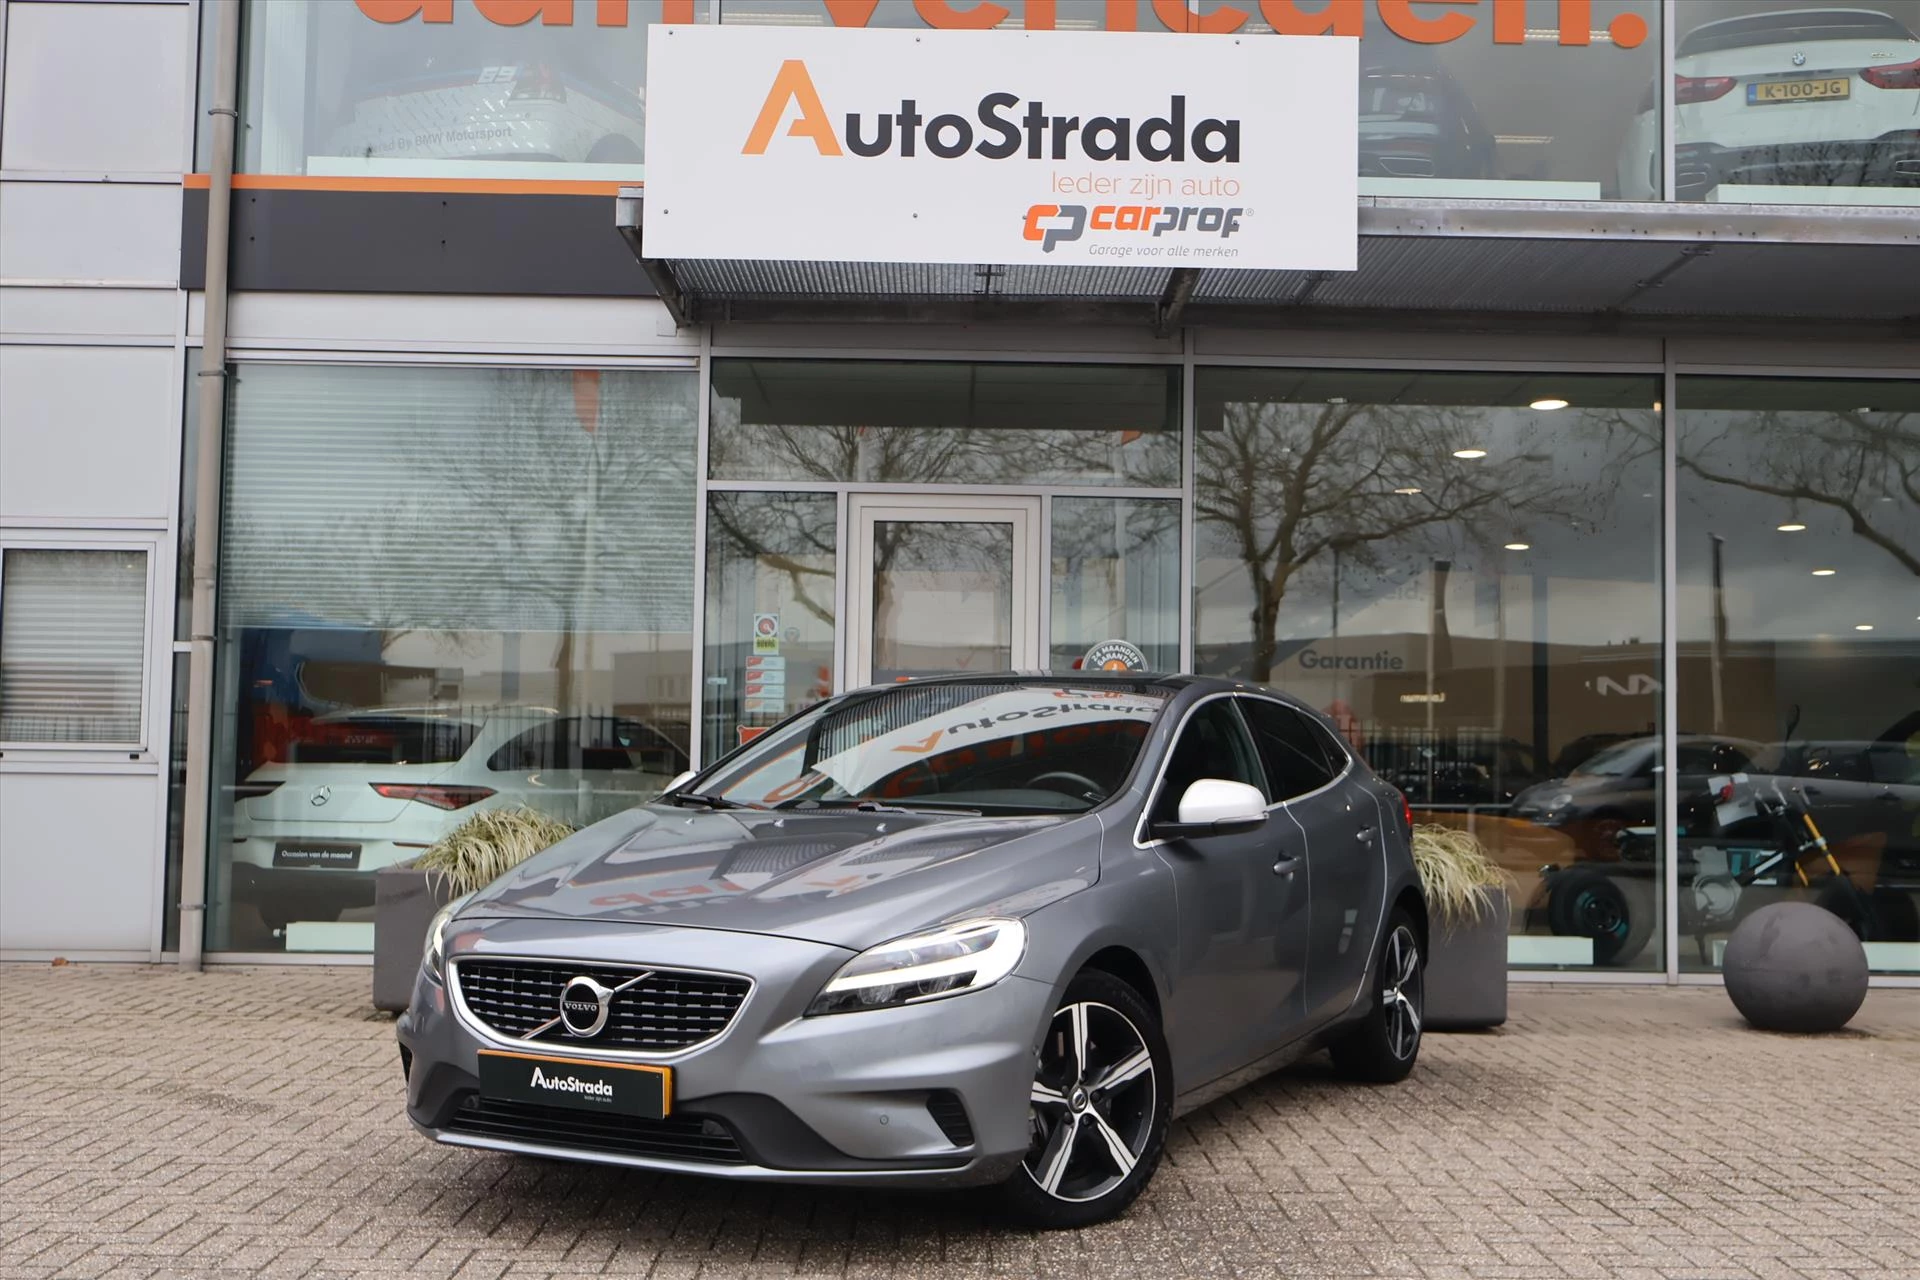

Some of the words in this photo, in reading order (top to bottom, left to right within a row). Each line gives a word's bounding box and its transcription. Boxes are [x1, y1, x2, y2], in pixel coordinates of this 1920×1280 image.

[1765, 81, 1841, 98] K-100-JG
[741, 59, 1240, 162] AutoStrada
[416, 132, 443, 146] BMW
[446, 126, 512, 143] Motorsport
[1052, 171, 1121, 194] Ieder
[1130, 173, 1172, 200] zijn
[1181, 175, 1240, 197] auto
[1089, 244, 1132, 258] Garage
[1137, 248, 1162, 256] voor
[1167, 245, 1189, 256] alle
[1194, 246, 1239, 257] merken
[1091, 650, 1102, 662] 24
[1101, 645, 1140, 663] MAANDEN
[1097, 652, 1134, 668] GARANTIE
[1299, 649, 1403, 670] Garantie
[309, 851, 320, 859] van
[321, 849, 330, 858] de
[330, 850, 353, 859] maand
[565, 1002, 597, 1012] VOLVO
[530, 1066, 613, 1096] AutoStrada
